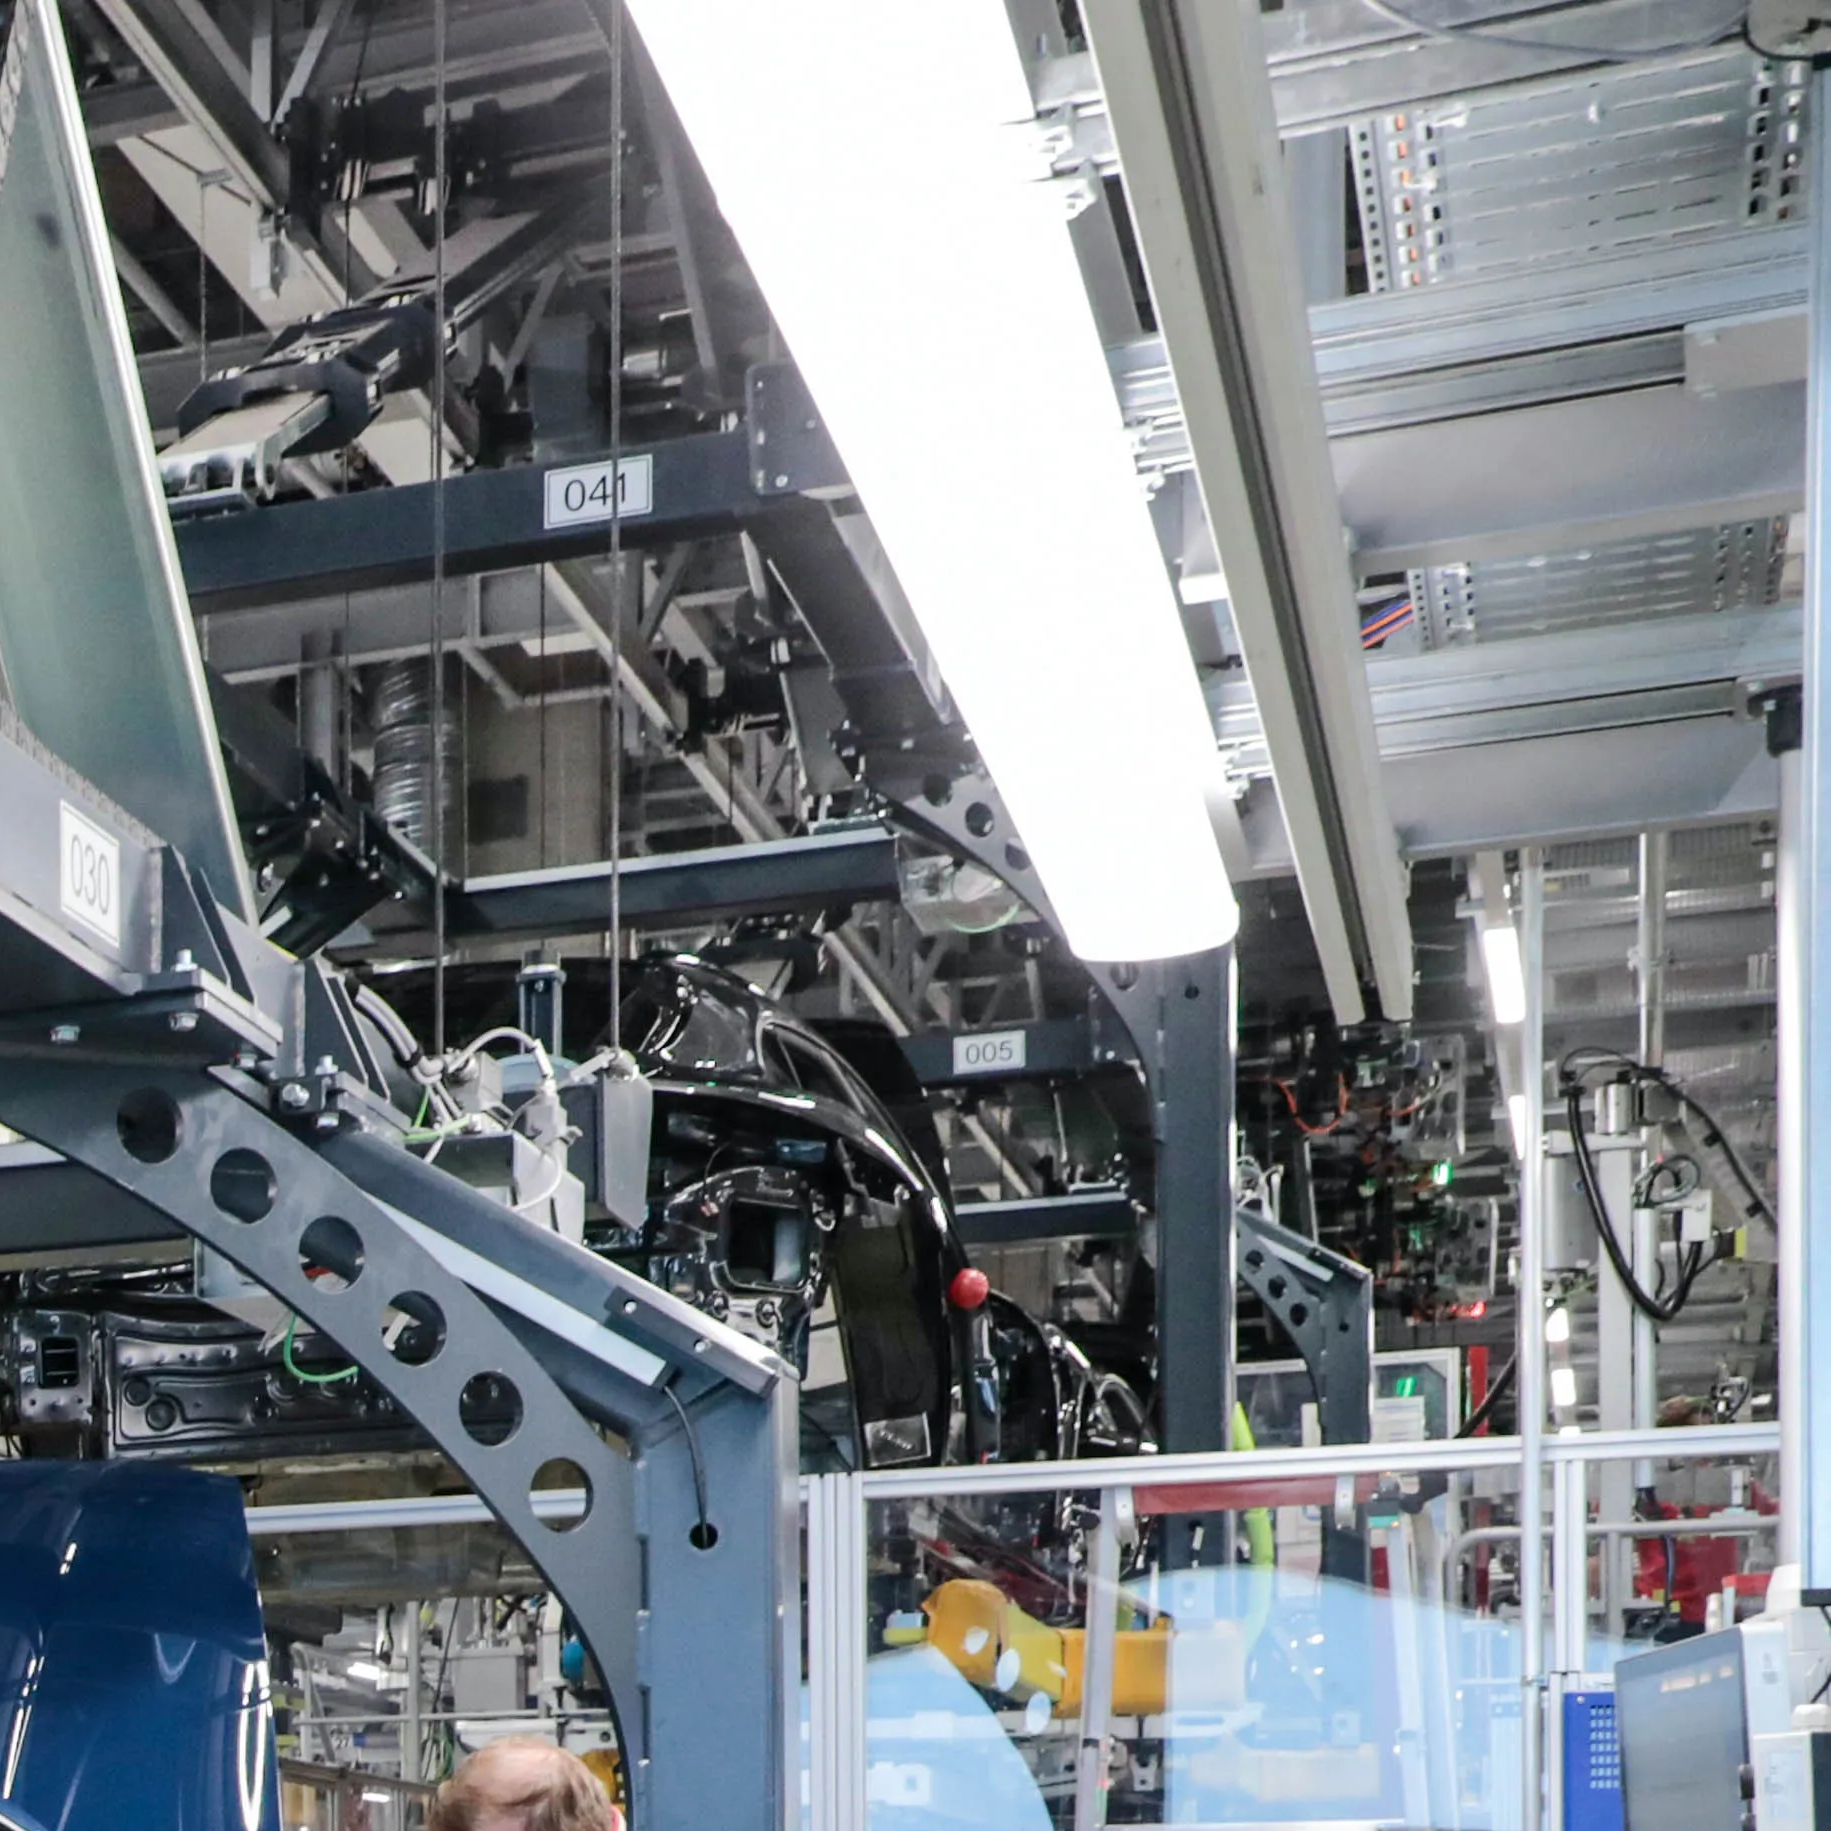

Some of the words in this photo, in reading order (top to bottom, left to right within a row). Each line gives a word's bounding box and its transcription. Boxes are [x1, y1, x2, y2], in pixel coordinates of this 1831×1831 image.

[564, 471, 626, 512] 041
[70, 833, 111, 916] 030
[965, 1039, 1013, 1065] 005
